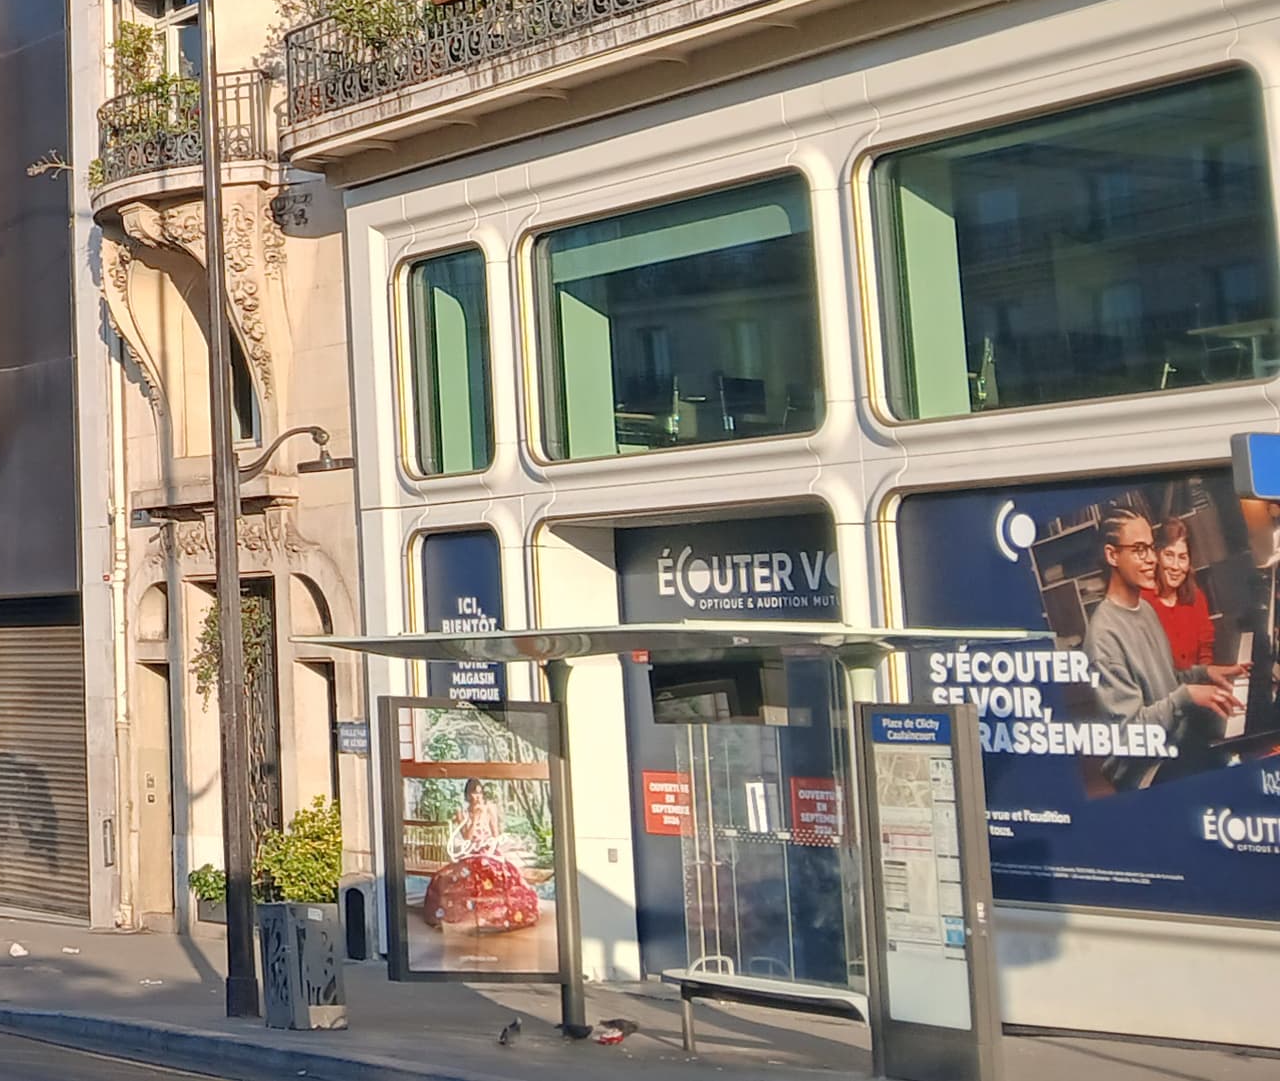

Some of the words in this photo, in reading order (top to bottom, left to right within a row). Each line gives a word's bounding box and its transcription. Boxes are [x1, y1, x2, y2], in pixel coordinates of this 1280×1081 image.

[657, 546, 794, 607] ÉCOUTER
[458, 597, 482, 616] ICI,
[699, 597, 744, 610] OPTIQUE
[747, 598, 754, 609] &
[757, 596, 808, 609] AUDITION
[813, 595, 840, 607] MUT
[442, 614, 497, 633] BIENTÔT
[929, 646, 1100, 688] S'ÉCOUTER,
[452, 672, 495, 685] MAGASIN
[449, 687, 500, 701] D'OPTIQUE
[970, 688, 1052, 723] VOIR,
[882, 718, 902, 728] Place
[904, 718, 914, 728] de
[915, 718, 940, 731] Clichy
[980, 722, 1179, 758] RASSEMBLER.
[1011, 811, 1023, 821] et
[1203, 808, 1280, 849] ÉCOUT
